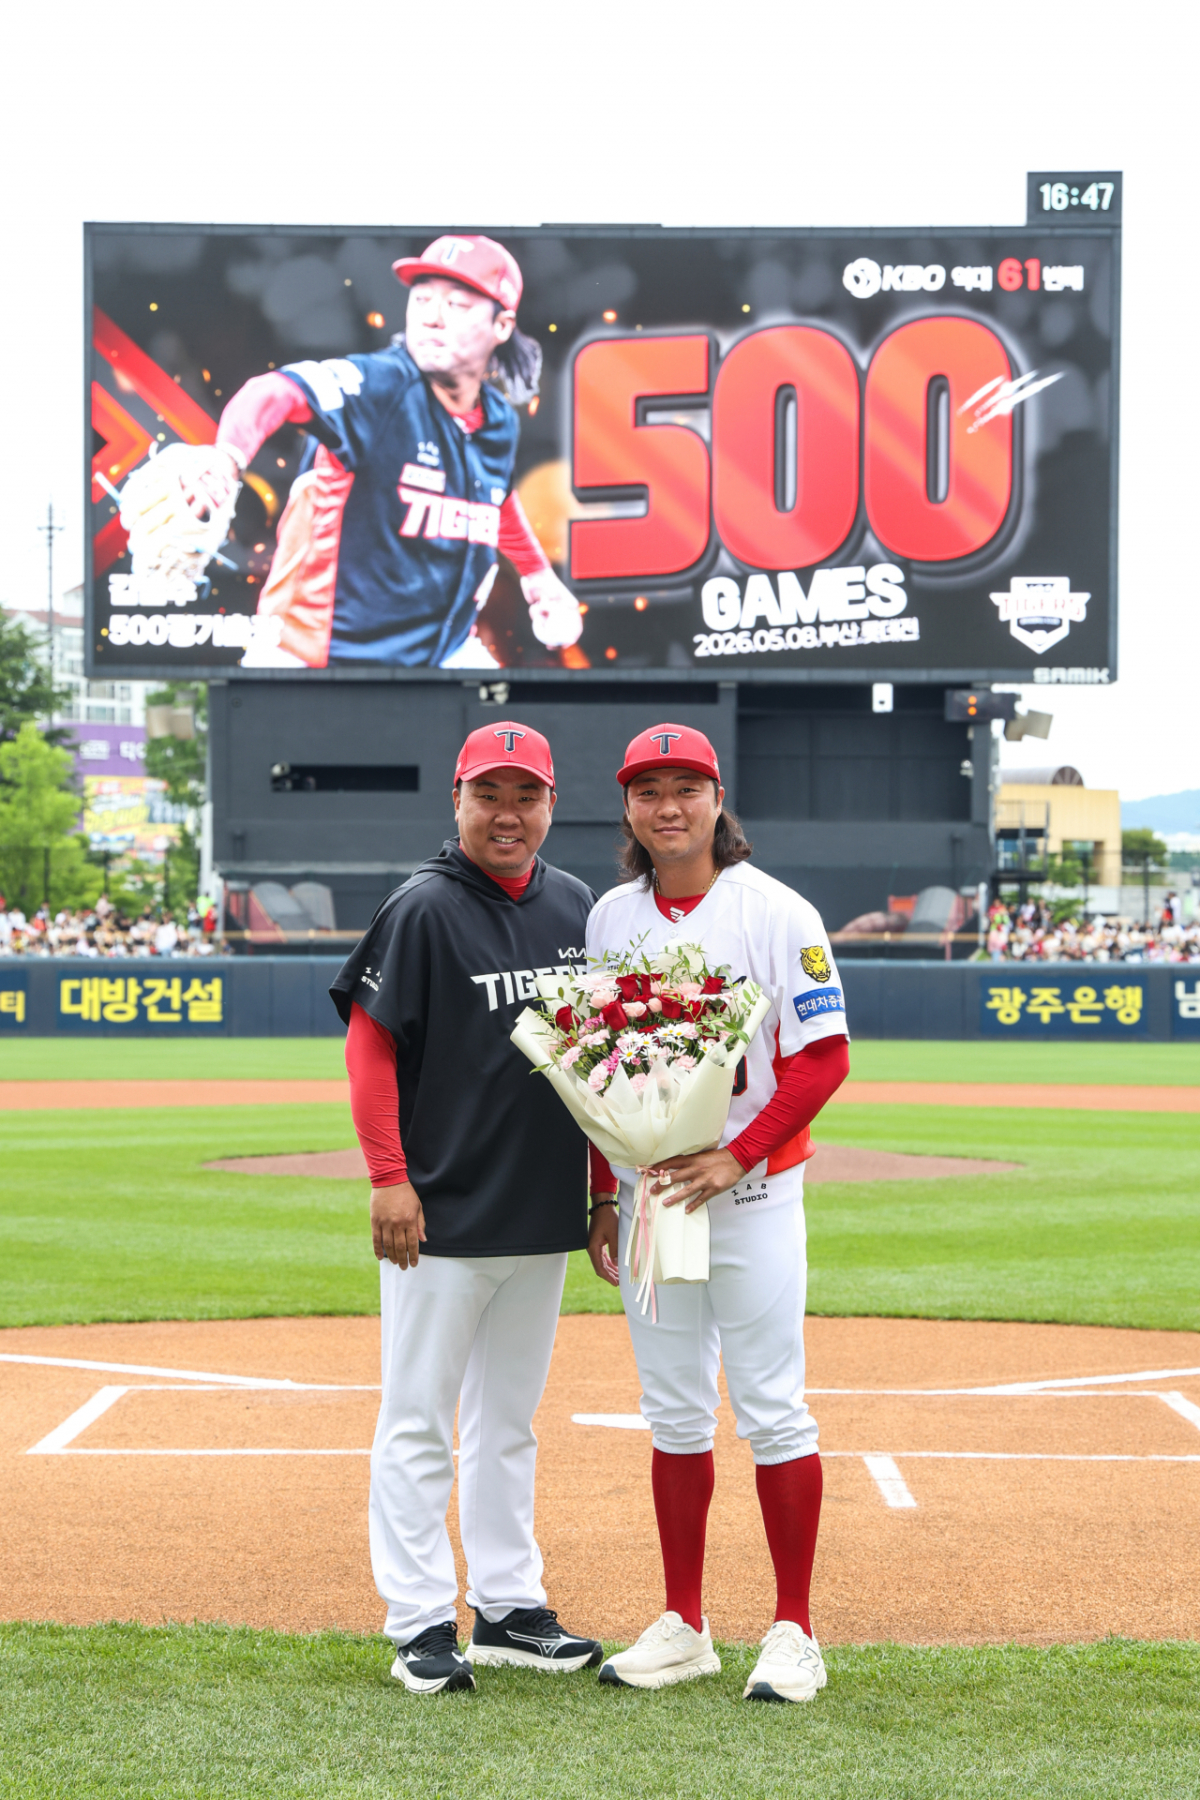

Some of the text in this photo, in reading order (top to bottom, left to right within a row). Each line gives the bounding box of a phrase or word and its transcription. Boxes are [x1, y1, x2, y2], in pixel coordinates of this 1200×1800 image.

[1040, 183, 1114, 210] 16:47
[881, 265, 946, 291] KBO
[571, 315, 1014, 580] 500
[701, 562, 908, 631] GAMES
[493, 729, 527, 754] T
[649, 732, 682, 756] T
[0, 990, 26, 1023] 터
[60, 977, 224, 1023] 대방건설
[985, 985, 1143, 1025] 광주은행
[734, 1193, 768, 1206] STUDIO
